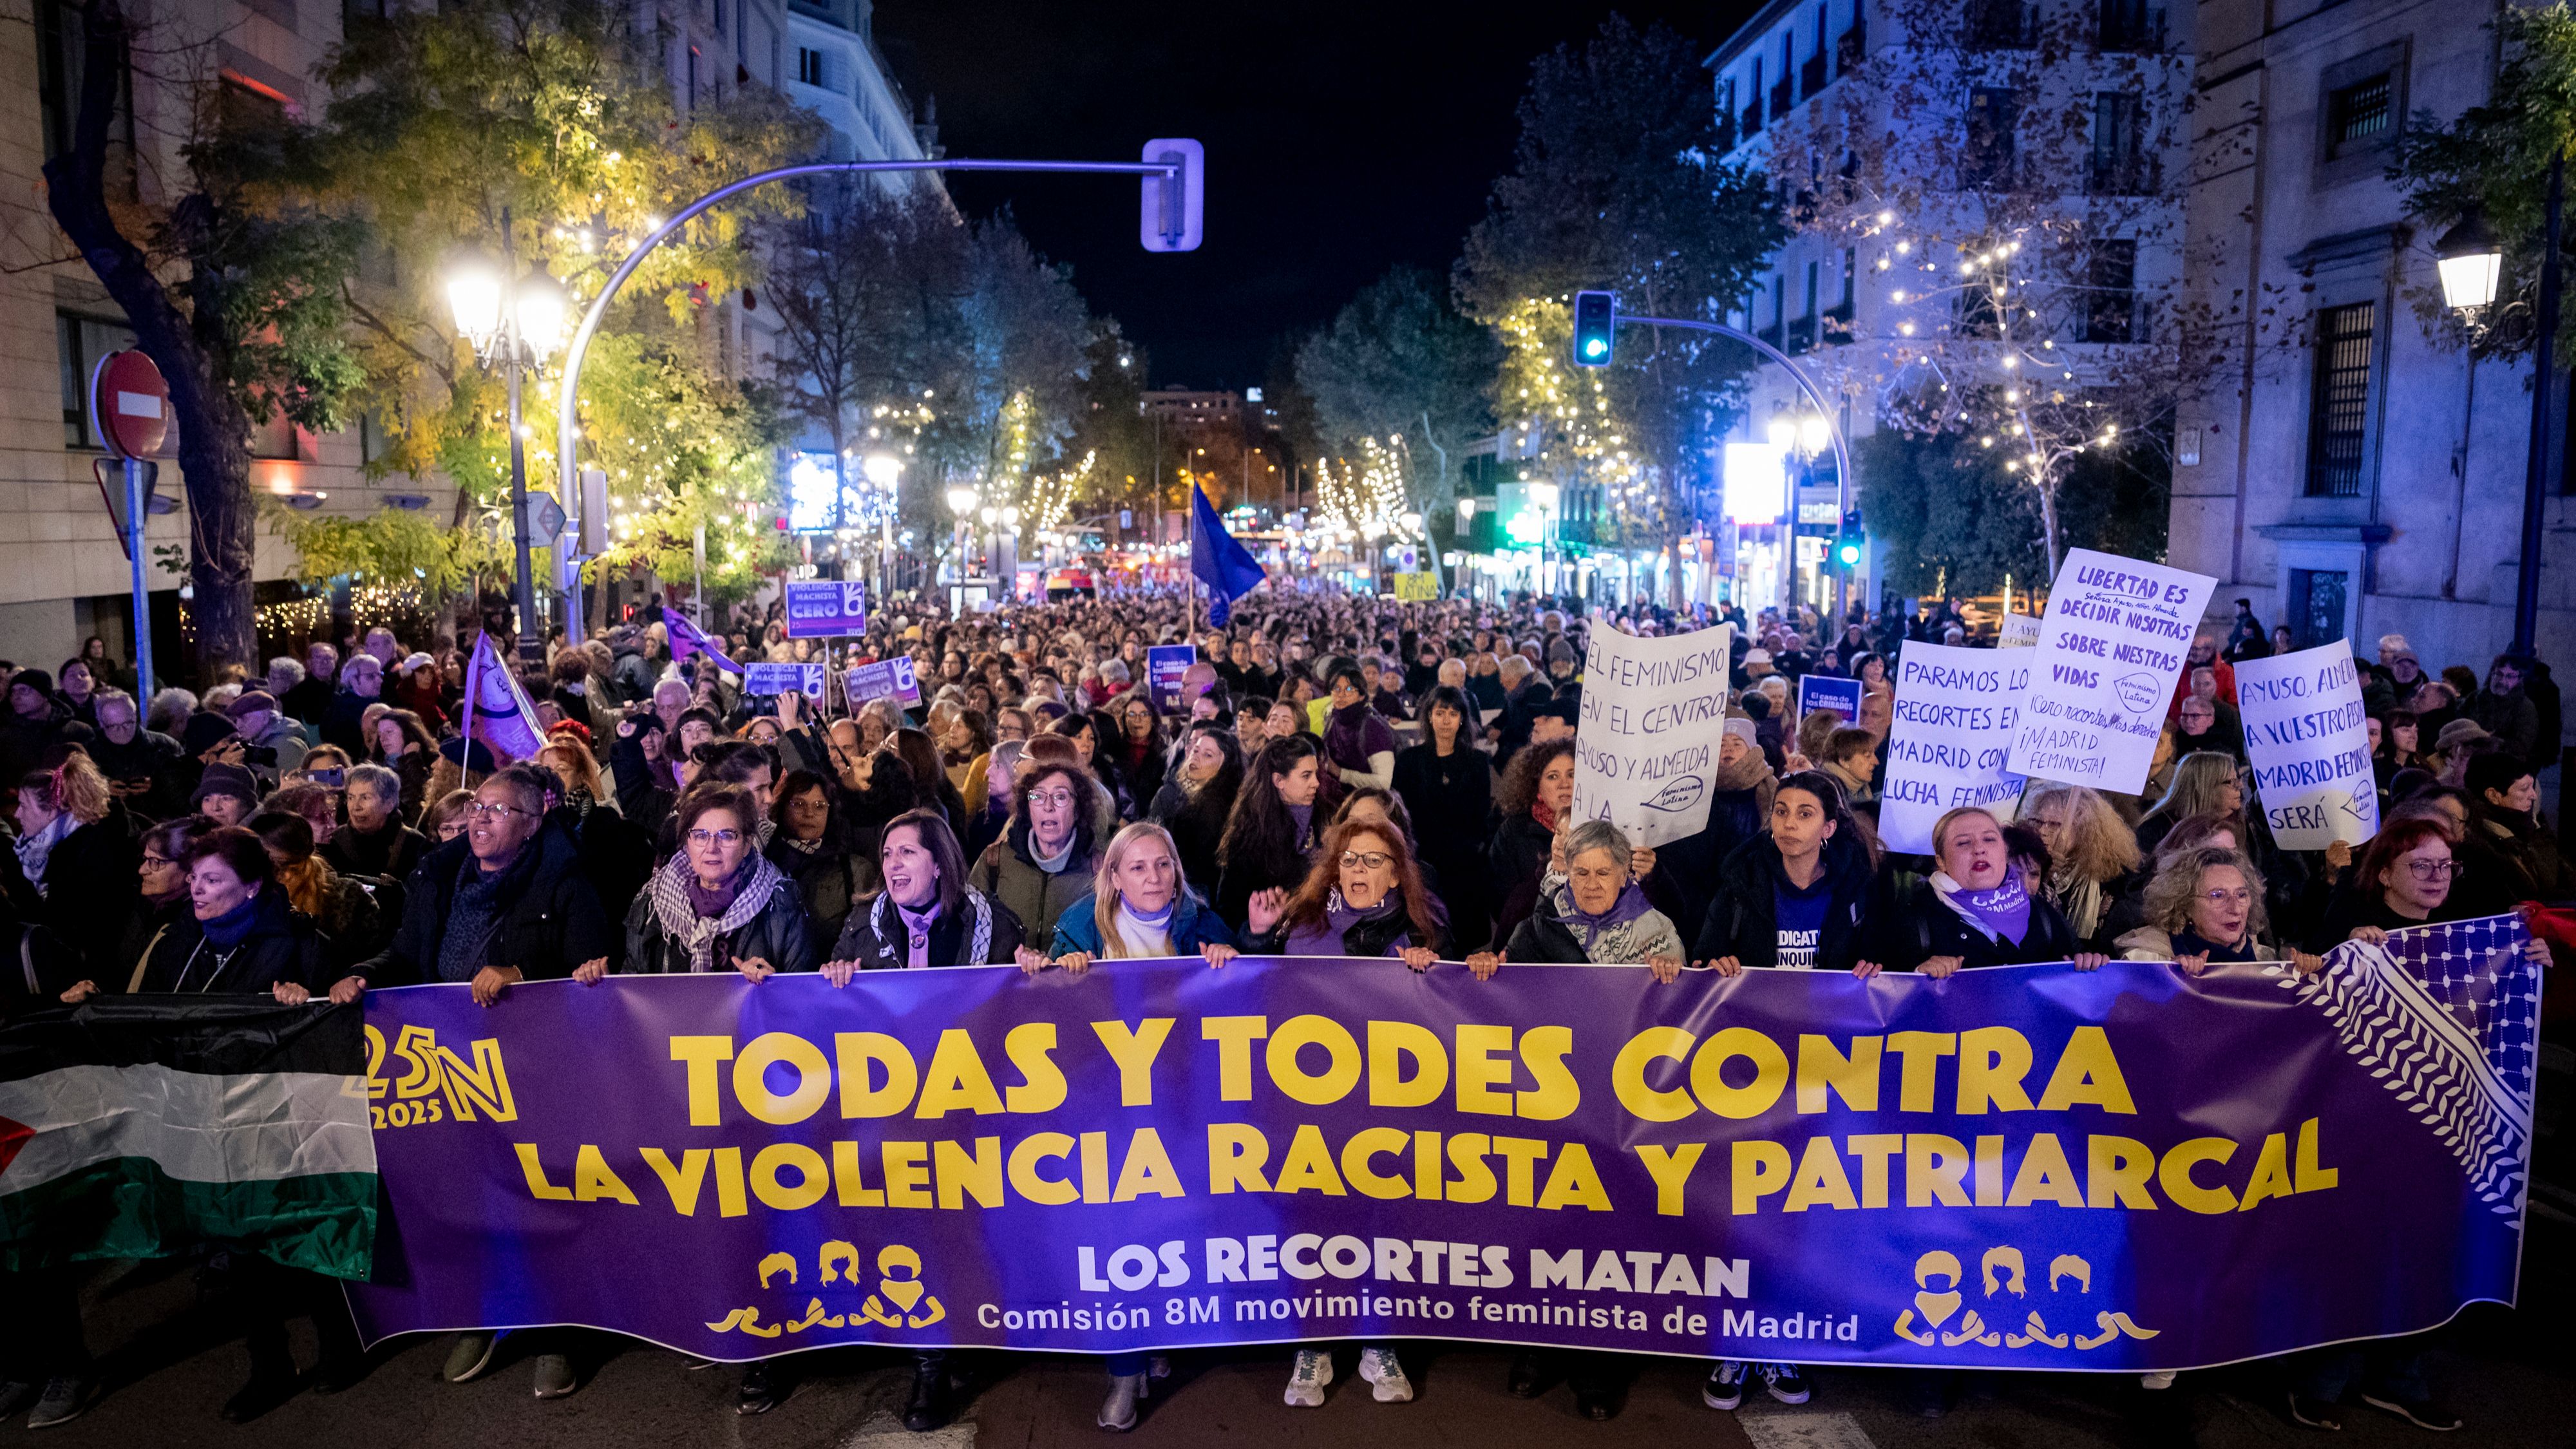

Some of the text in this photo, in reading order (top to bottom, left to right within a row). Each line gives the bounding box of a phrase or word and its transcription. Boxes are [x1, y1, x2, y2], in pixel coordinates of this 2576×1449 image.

[791, 583, 837, 591] VIOLENCIA
[795, 592, 837, 600] MACHISTA
[2077, 565, 2188, 604] LIBERTAD ES
[791, 602, 838, 618] CERO
[2060, 598, 2192, 641] DECIDIR NOSOTRAS
[2017, 625, 2041, 638] AYU
[1589, 640, 1725, 688] EL FEMINISMO
[2056, 632, 2178, 672] SOBRE NUESTRAS
[754, 674, 798, 682] MACHISTA
[1904, 661, 2029, 692] PARAMOS LO
[2053, 663, 2099, 689] VIDAS
[2241, 676, 2313, 706] AYUSO,
[849, 681, 893, 703] CERO
[1806, 698, 1819, 707] los
[1581, 689, 1601, 723] EN
[1611, 705, 1636, 736] EL
[1896, 699, 1992, 730] RECORTES
[2246, 724, 2263, 748] A
[1577, 737, 1709, 781] AYUSO Y ALMEIDA
[1889, 738, 2009, 770] MADRID CON
[2029, 751, 2106, 779] FEMINISTA!
[2254, 759, 2334, 790] MADRID
[1573, 782, 1582, 812] A
[1883, 779, 2023, 808] LUCHA FEMINISTA
[2269, 795, 2329, 830] SERÁ
[2003, 893, 2025, 911] Madrid
[1777, 929, 1821, 947] DICAT
[339, 1023, 518, 1122] 25N
[670, 1014, 2137, 1126] TODAS Y TODES CONTRA
[370, 1098, 443, 1130] 2025
[514, 1117, 2338, 1218] LA VIOLENCIA RACISTA Y PATRIARCAL
[1077, 1233, 1750, 1298] LOS RECORTES MATAN
[978, 1289, 1857, 1341] Comisión 8M movimiento feminista de Madrid
